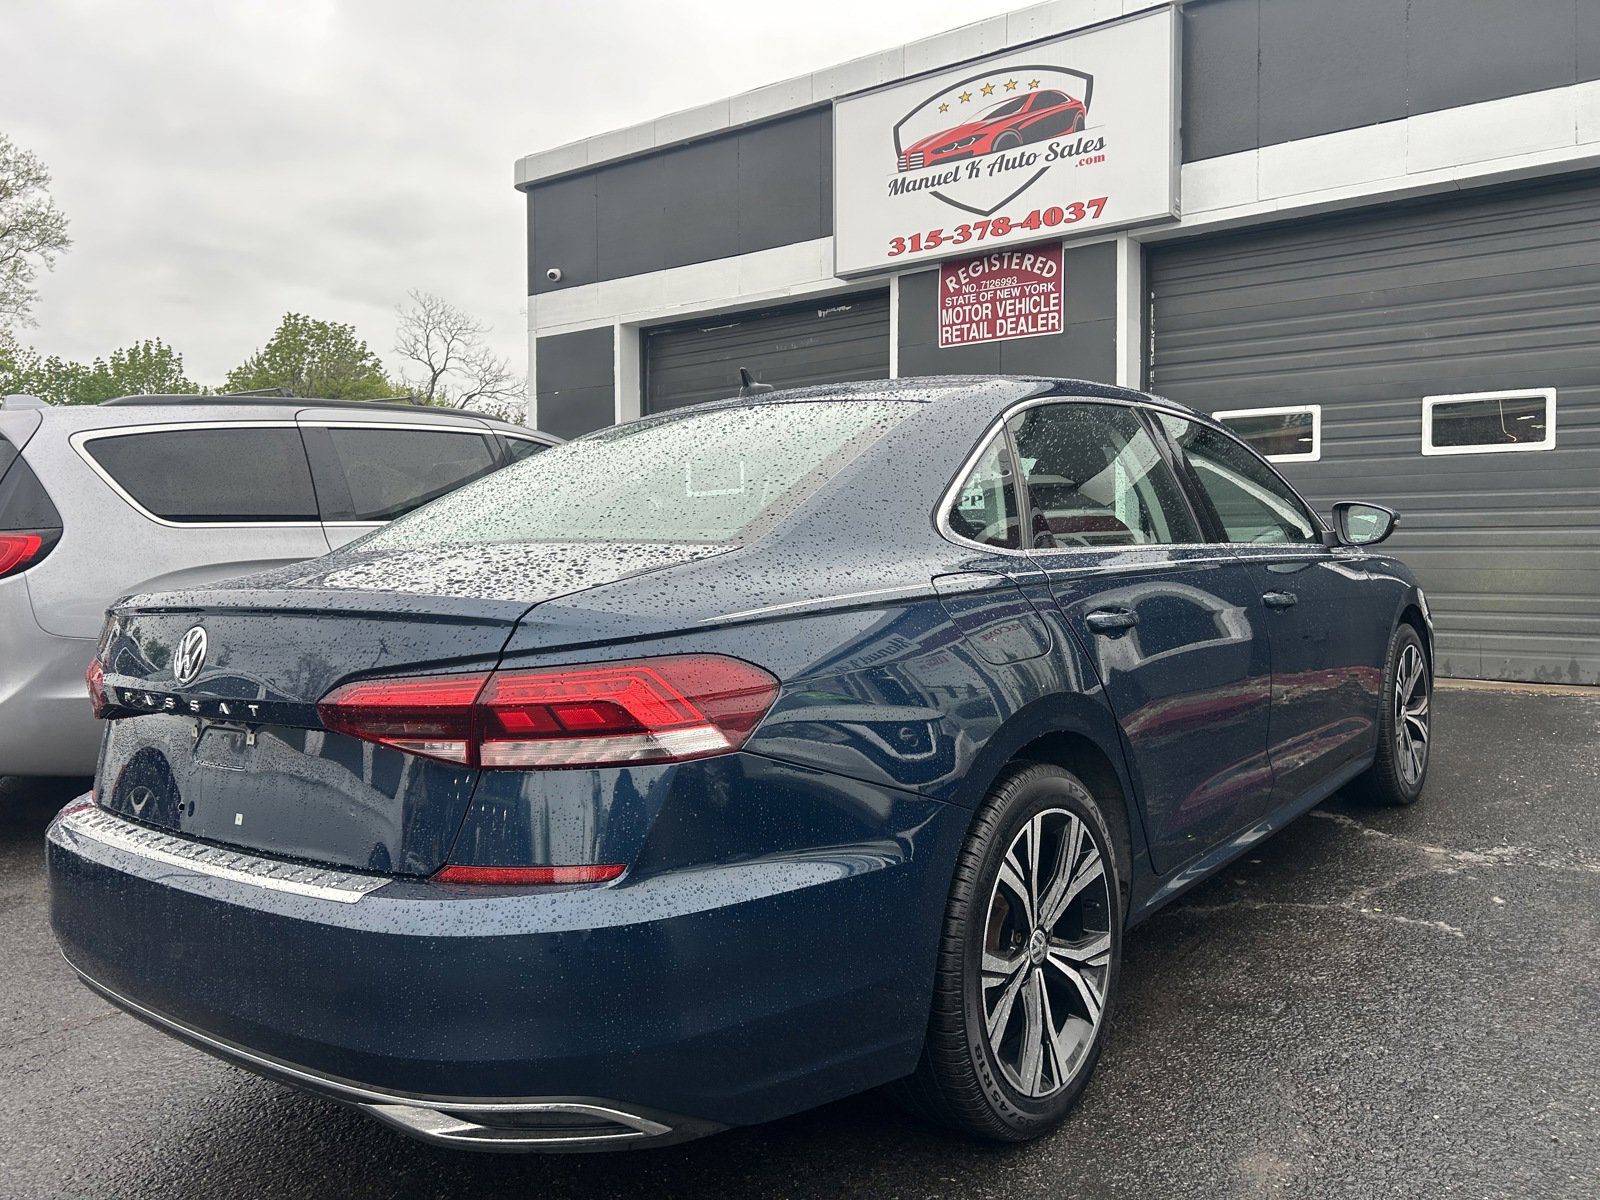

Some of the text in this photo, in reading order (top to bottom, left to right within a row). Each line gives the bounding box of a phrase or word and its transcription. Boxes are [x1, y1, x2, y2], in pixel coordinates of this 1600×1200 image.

[888, 136, 1107, 197] Manuel K Auto Sales
[1075, 154, 1106, 168] .com
[887, 196, 1109, 257] 315-378-4037
[945, 252, 1057, 293] REGISTERED
[962, 276, 1018, 294] NO. 7126993
[942, 293, 1060, 326] MOTOR VEHICLE
[945, 281, 1056, 307] STATE OF NEW YORK
[942, 312, 1060, 344] RETAIL DEALER
[124, 691, 259, 717] PASSAT
